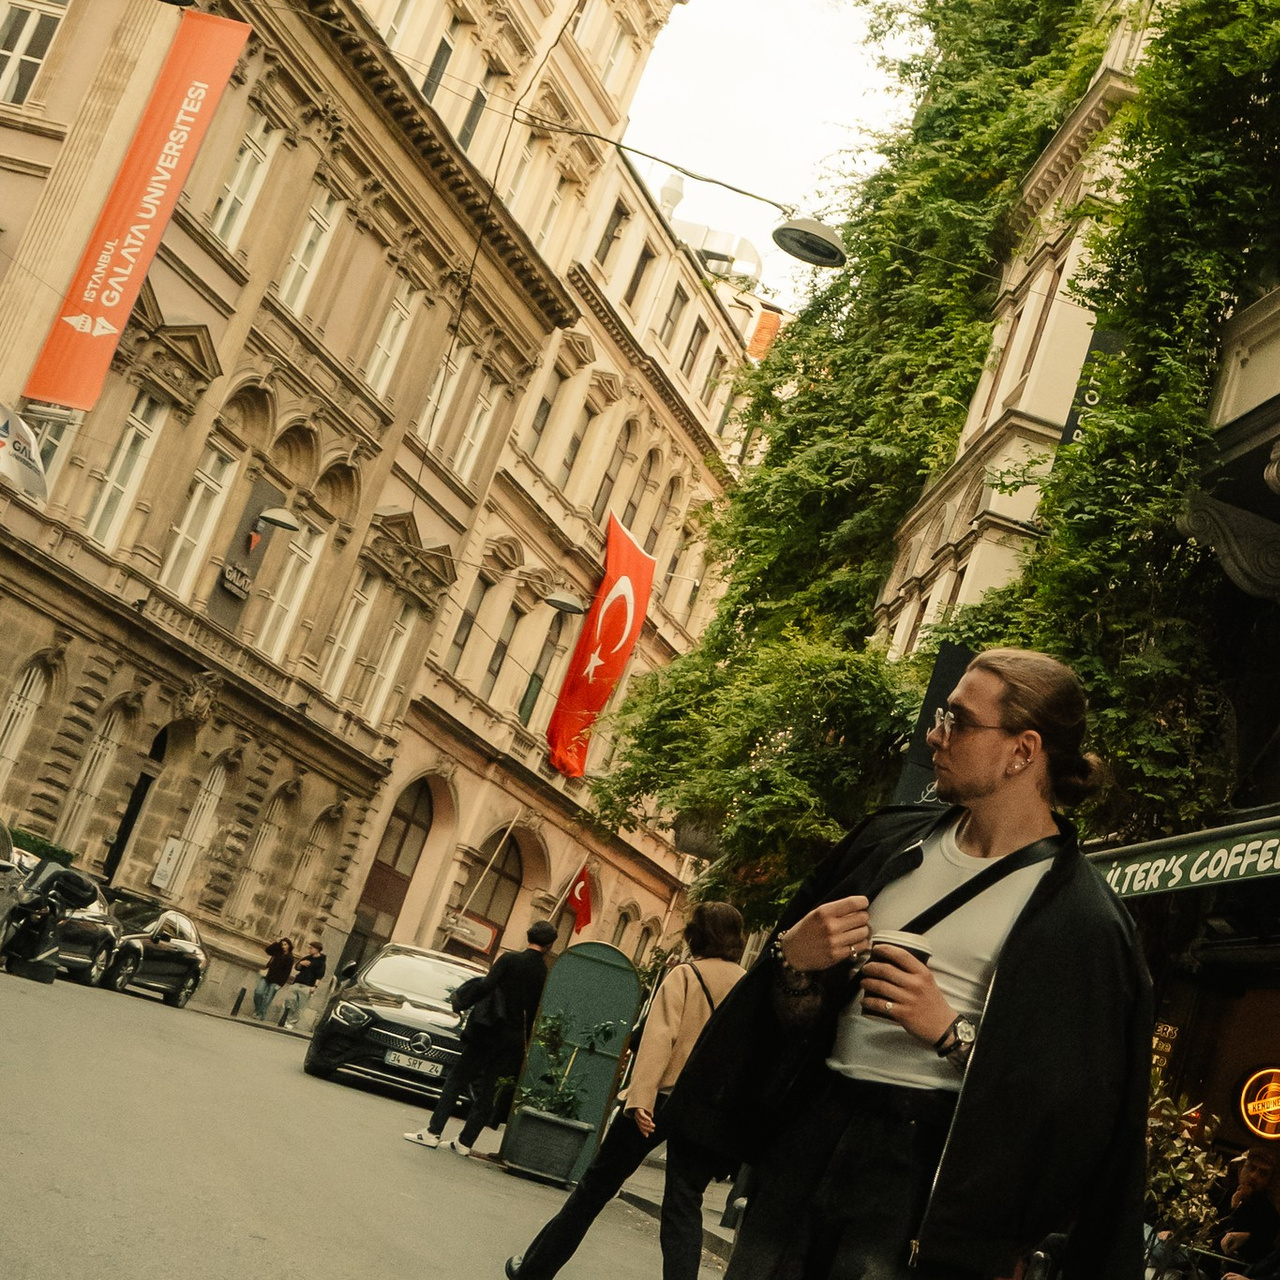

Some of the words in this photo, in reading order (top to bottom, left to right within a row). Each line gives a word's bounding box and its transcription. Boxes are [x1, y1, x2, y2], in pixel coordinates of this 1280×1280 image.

[101, 224, 150, 307] GALATA
[390, 1053, 401, 1064] 34
[428, 1063, 440, 1075] 24
